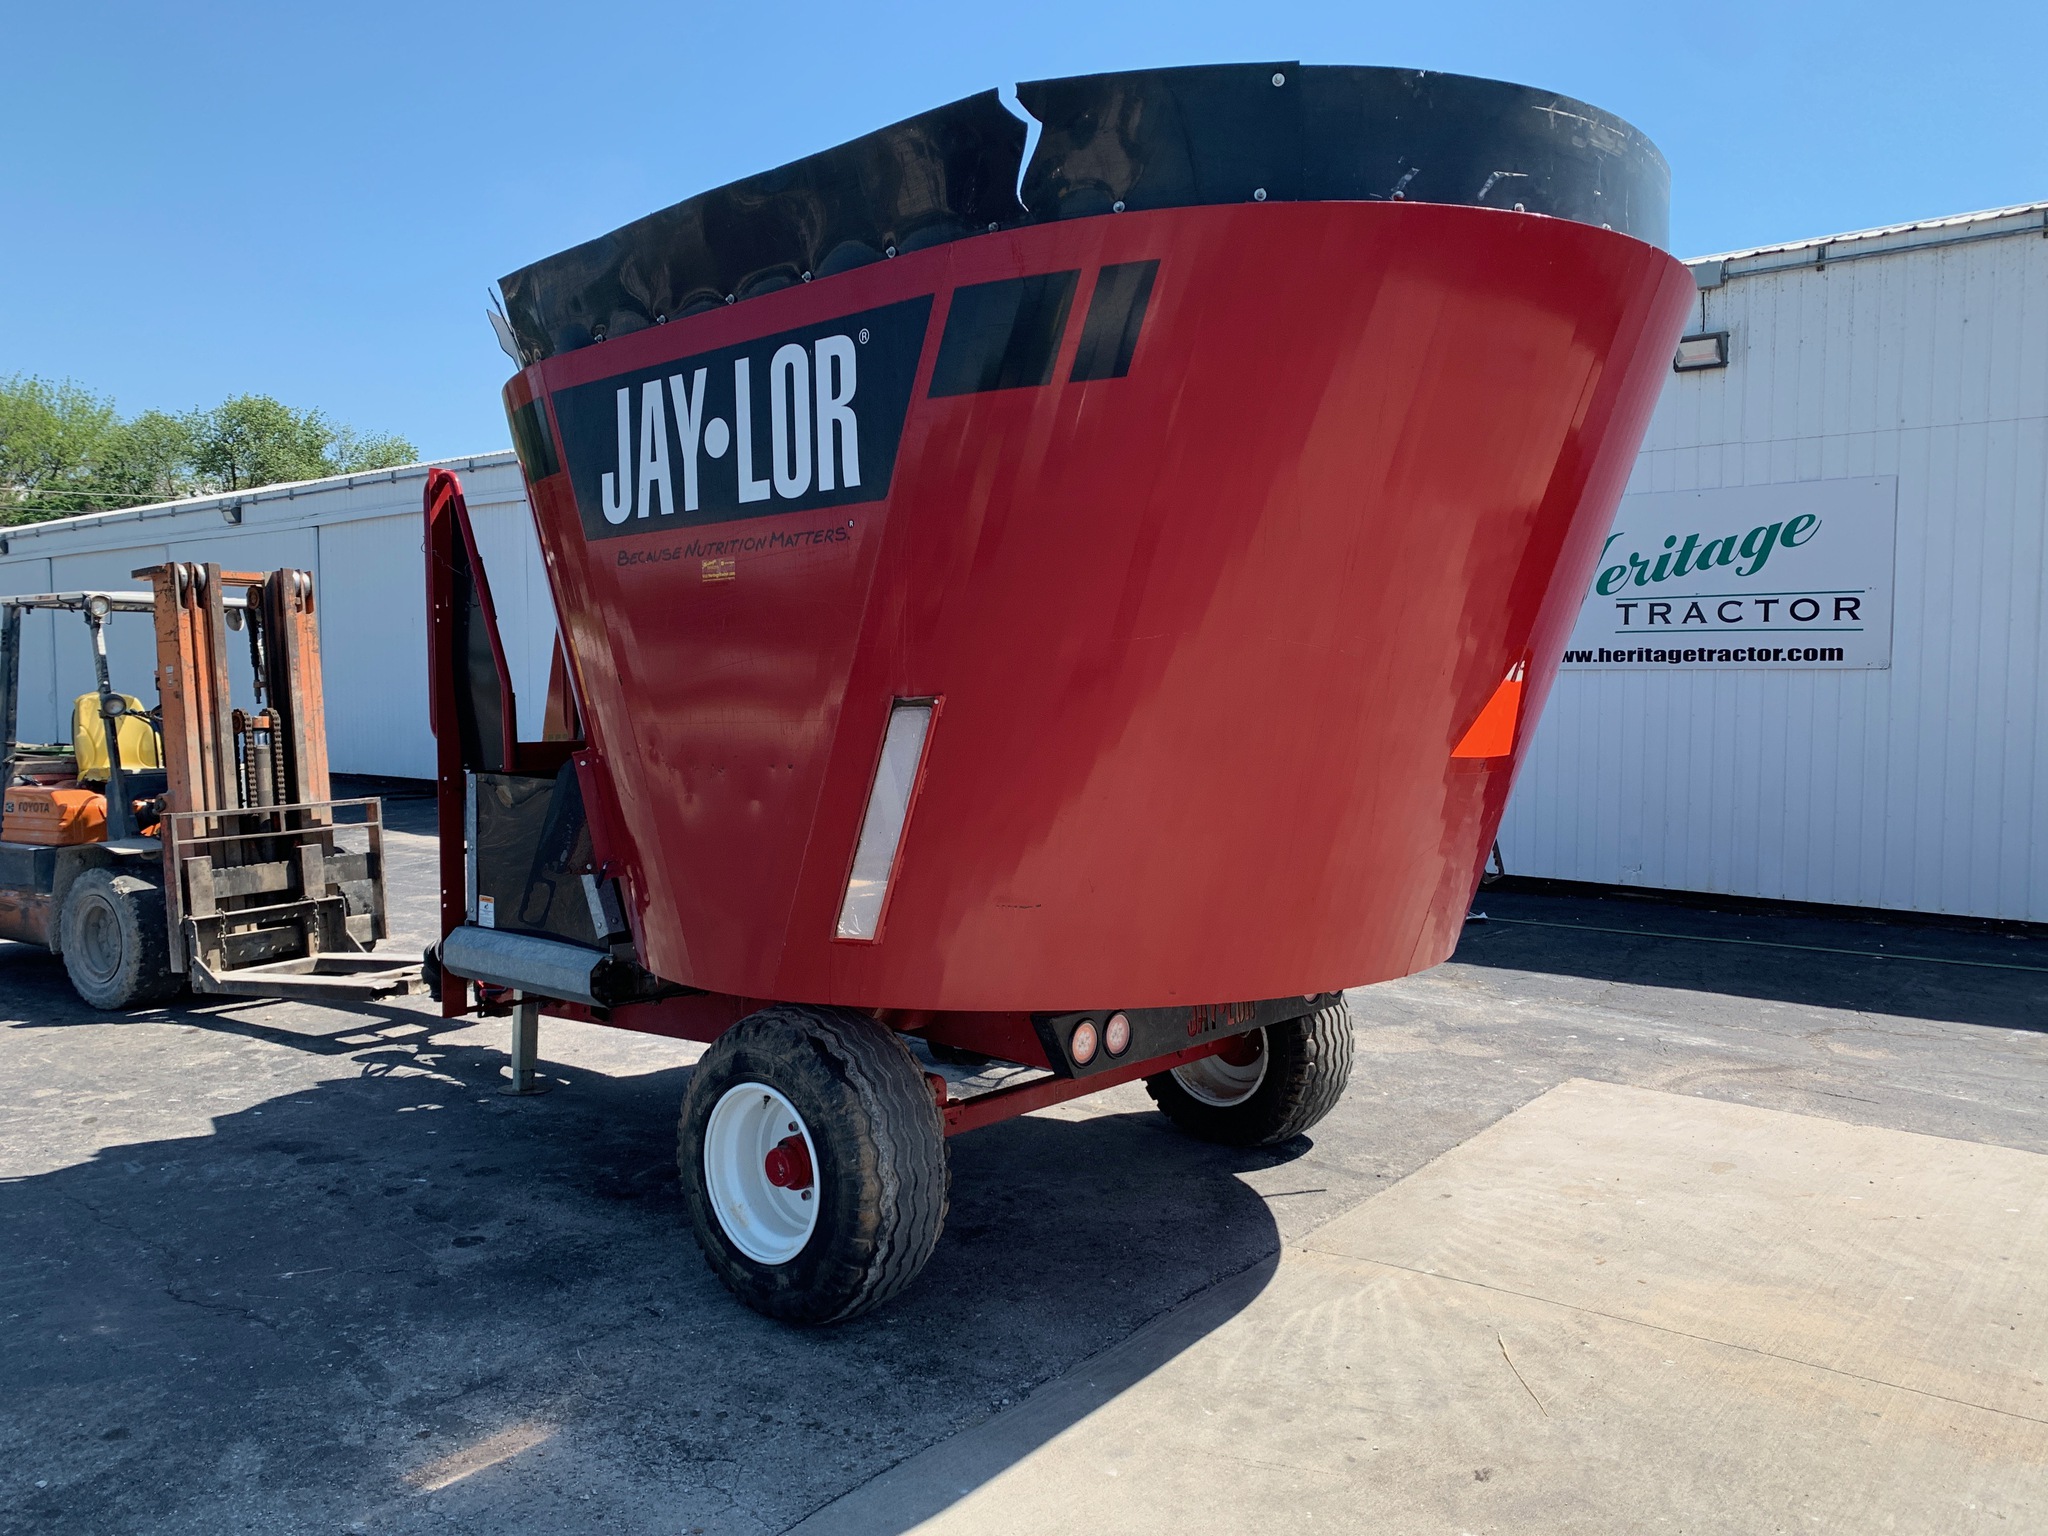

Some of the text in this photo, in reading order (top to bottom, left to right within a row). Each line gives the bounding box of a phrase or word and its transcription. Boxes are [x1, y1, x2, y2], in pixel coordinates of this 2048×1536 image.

[685, 536, 767, 558] NUTRITION
[1615, 596, 1862, 626] TRACTOR
[1561, 646, 1844, 664] ww.heritagetractor.com
[18, 801, 50, 813] TOYOTA
